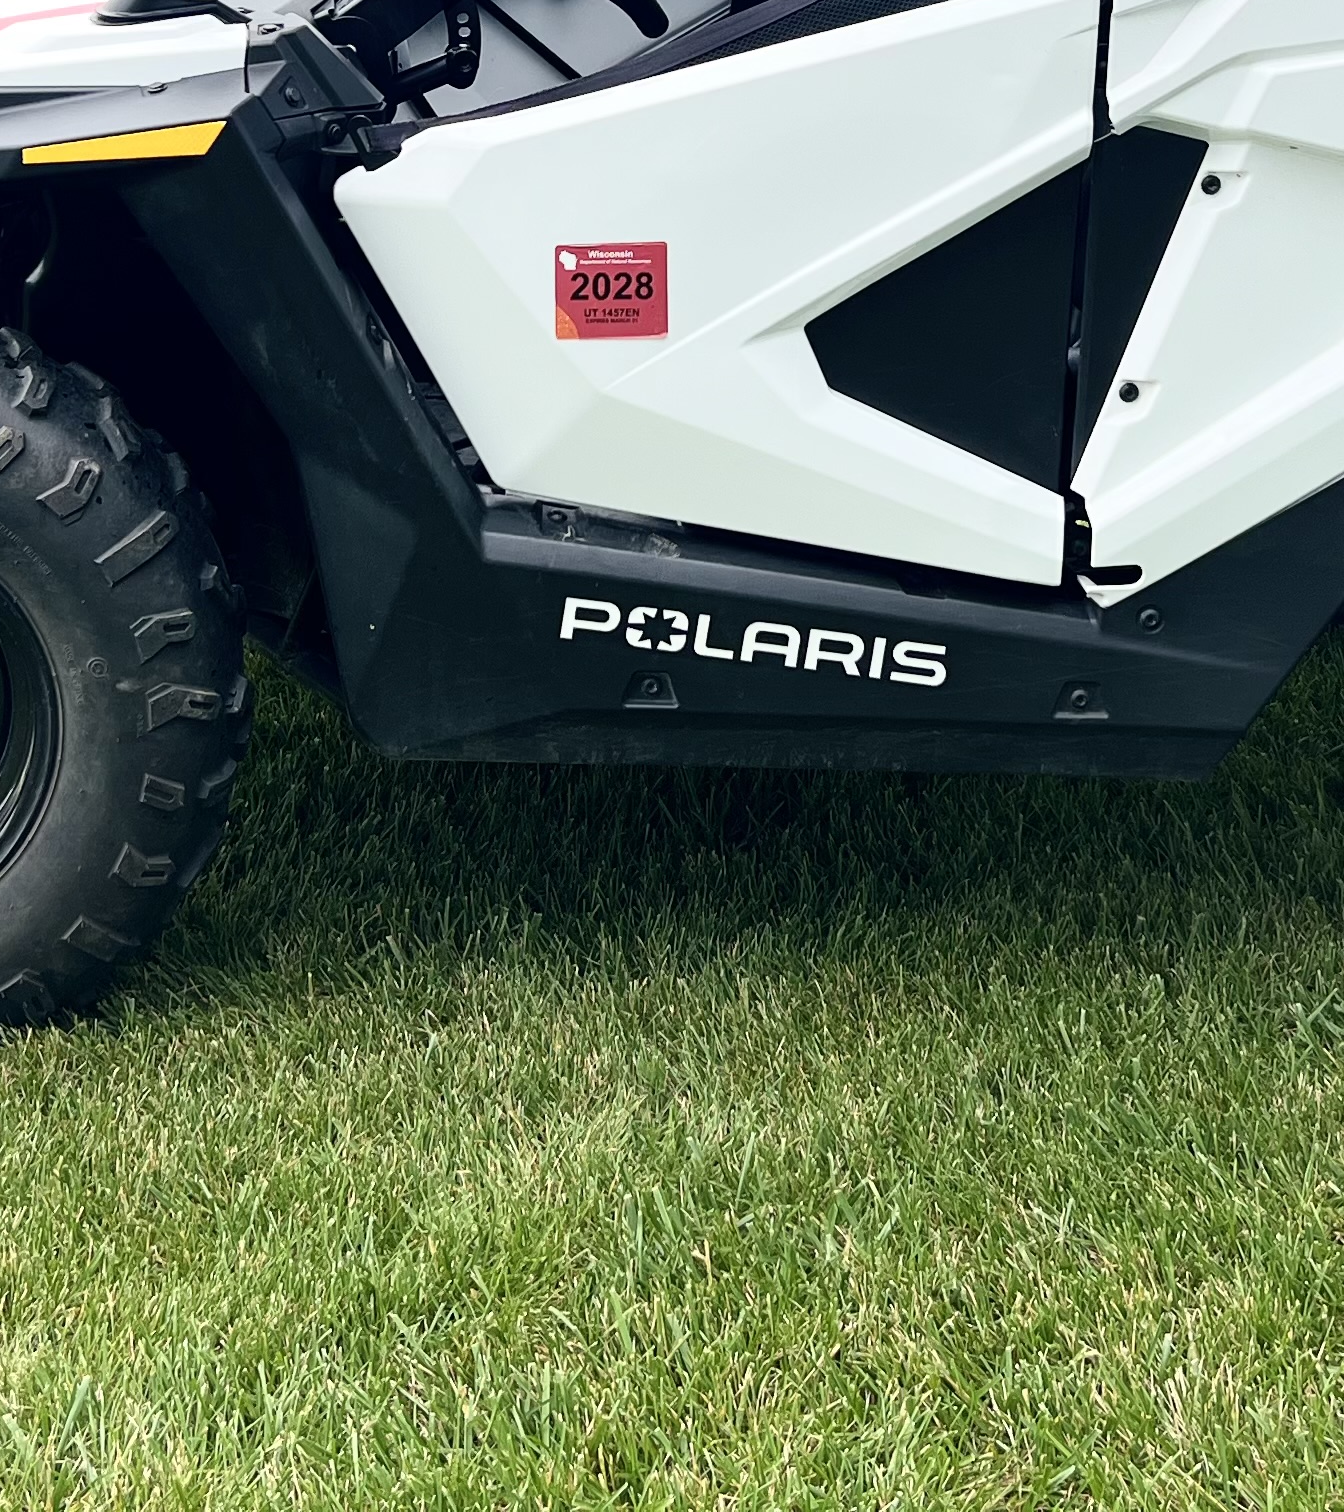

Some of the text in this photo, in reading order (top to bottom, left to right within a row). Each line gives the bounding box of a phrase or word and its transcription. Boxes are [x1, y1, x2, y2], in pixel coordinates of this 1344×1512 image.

[587, 249, 634, 259] Wisconsin
[570, 271, 654, 301] 2028
[584, 308, 599, 318] UT
[559, 596, 948, 688] POLARIS
